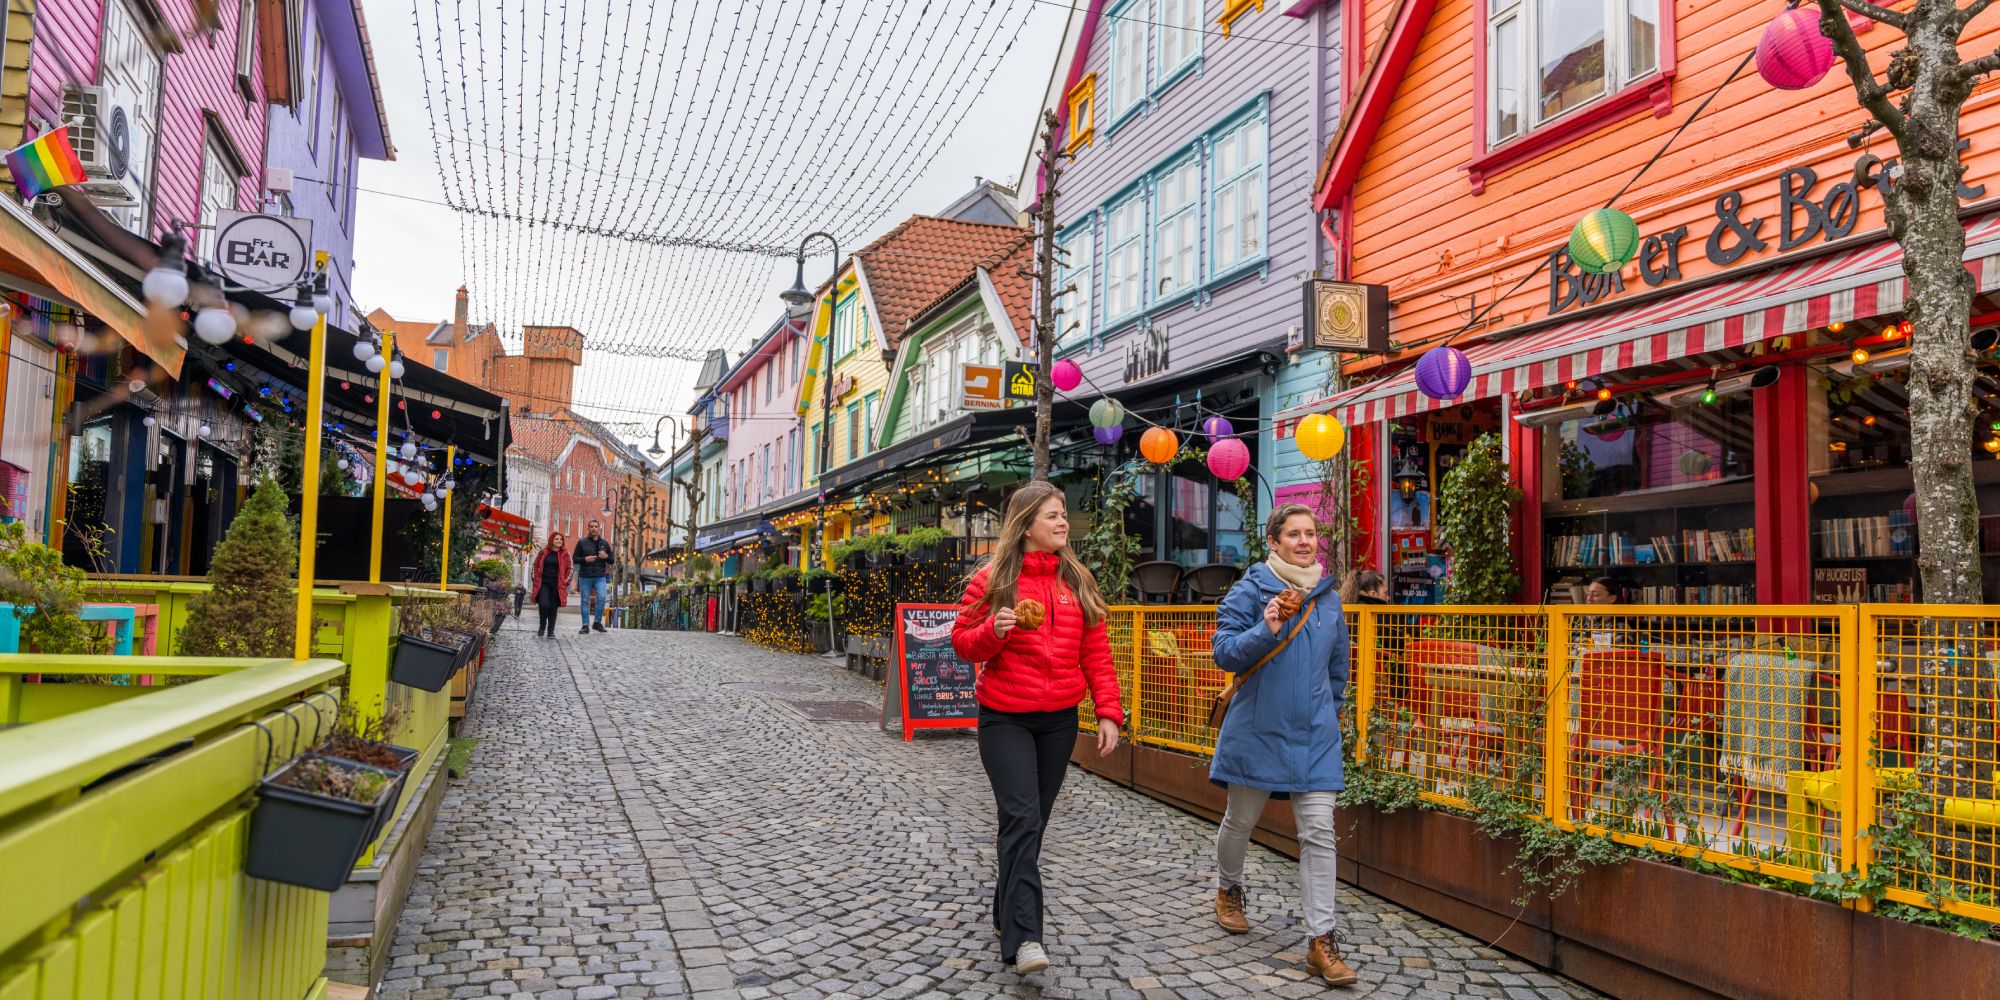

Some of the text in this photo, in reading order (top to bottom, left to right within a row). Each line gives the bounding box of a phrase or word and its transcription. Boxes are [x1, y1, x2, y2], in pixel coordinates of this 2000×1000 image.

[1705, 190, 1768, 266] &
[252, 238, 274, 248] Fri
[226, 240, 290, 269] BAR
[964, 400, 1000, 409] BERNINA
[1827, 568, 1851, 581] BUCKET
[935, 691, 954, 700] BRUS
[959, 690, 974, 700] JUS
